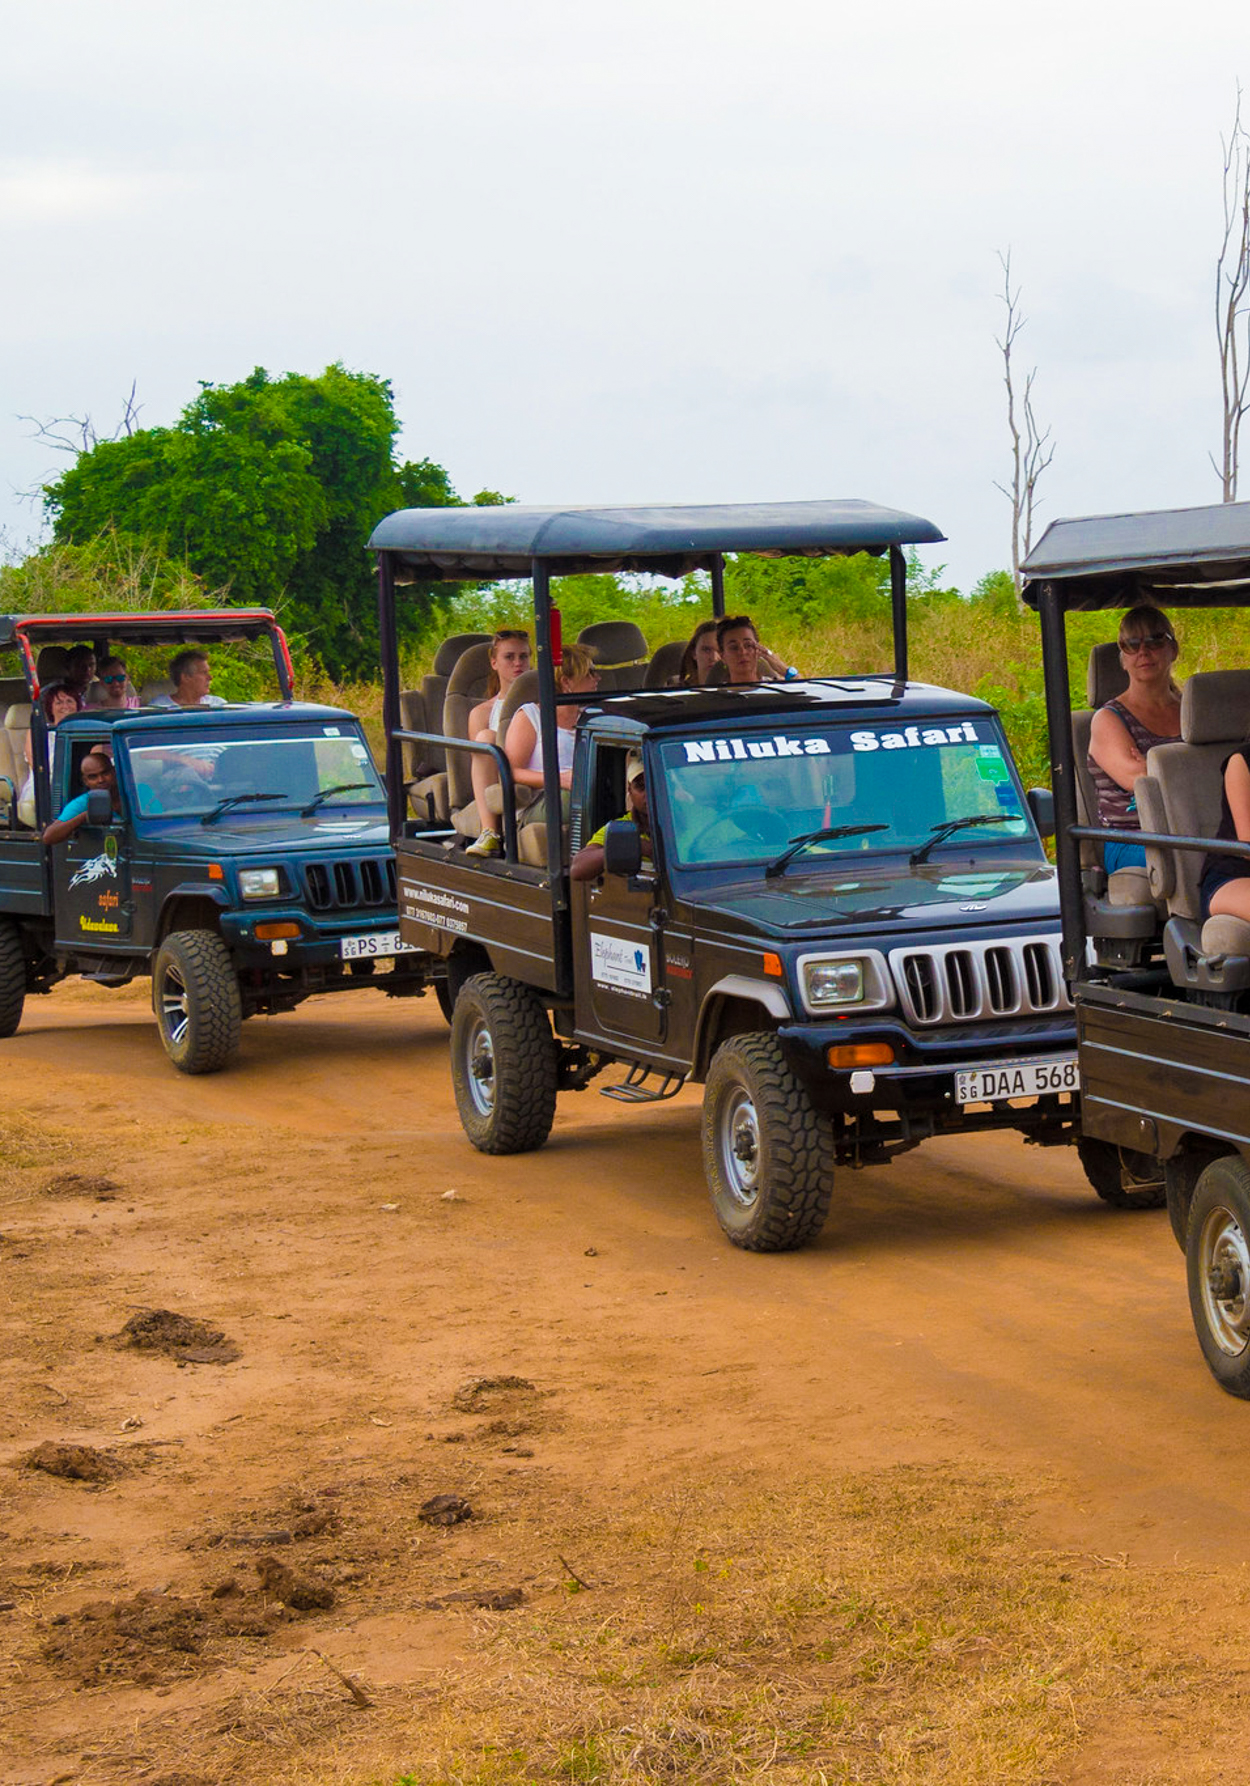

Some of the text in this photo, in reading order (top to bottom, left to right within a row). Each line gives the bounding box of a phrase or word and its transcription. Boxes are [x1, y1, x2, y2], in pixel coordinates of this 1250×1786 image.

[683, 721, 980, 763] Niluka Safari
[98, 889, 120, 912] safari
[358, 937, 378, 955] PS
[960, 1064, 1080, 1100] SG DAA 568
